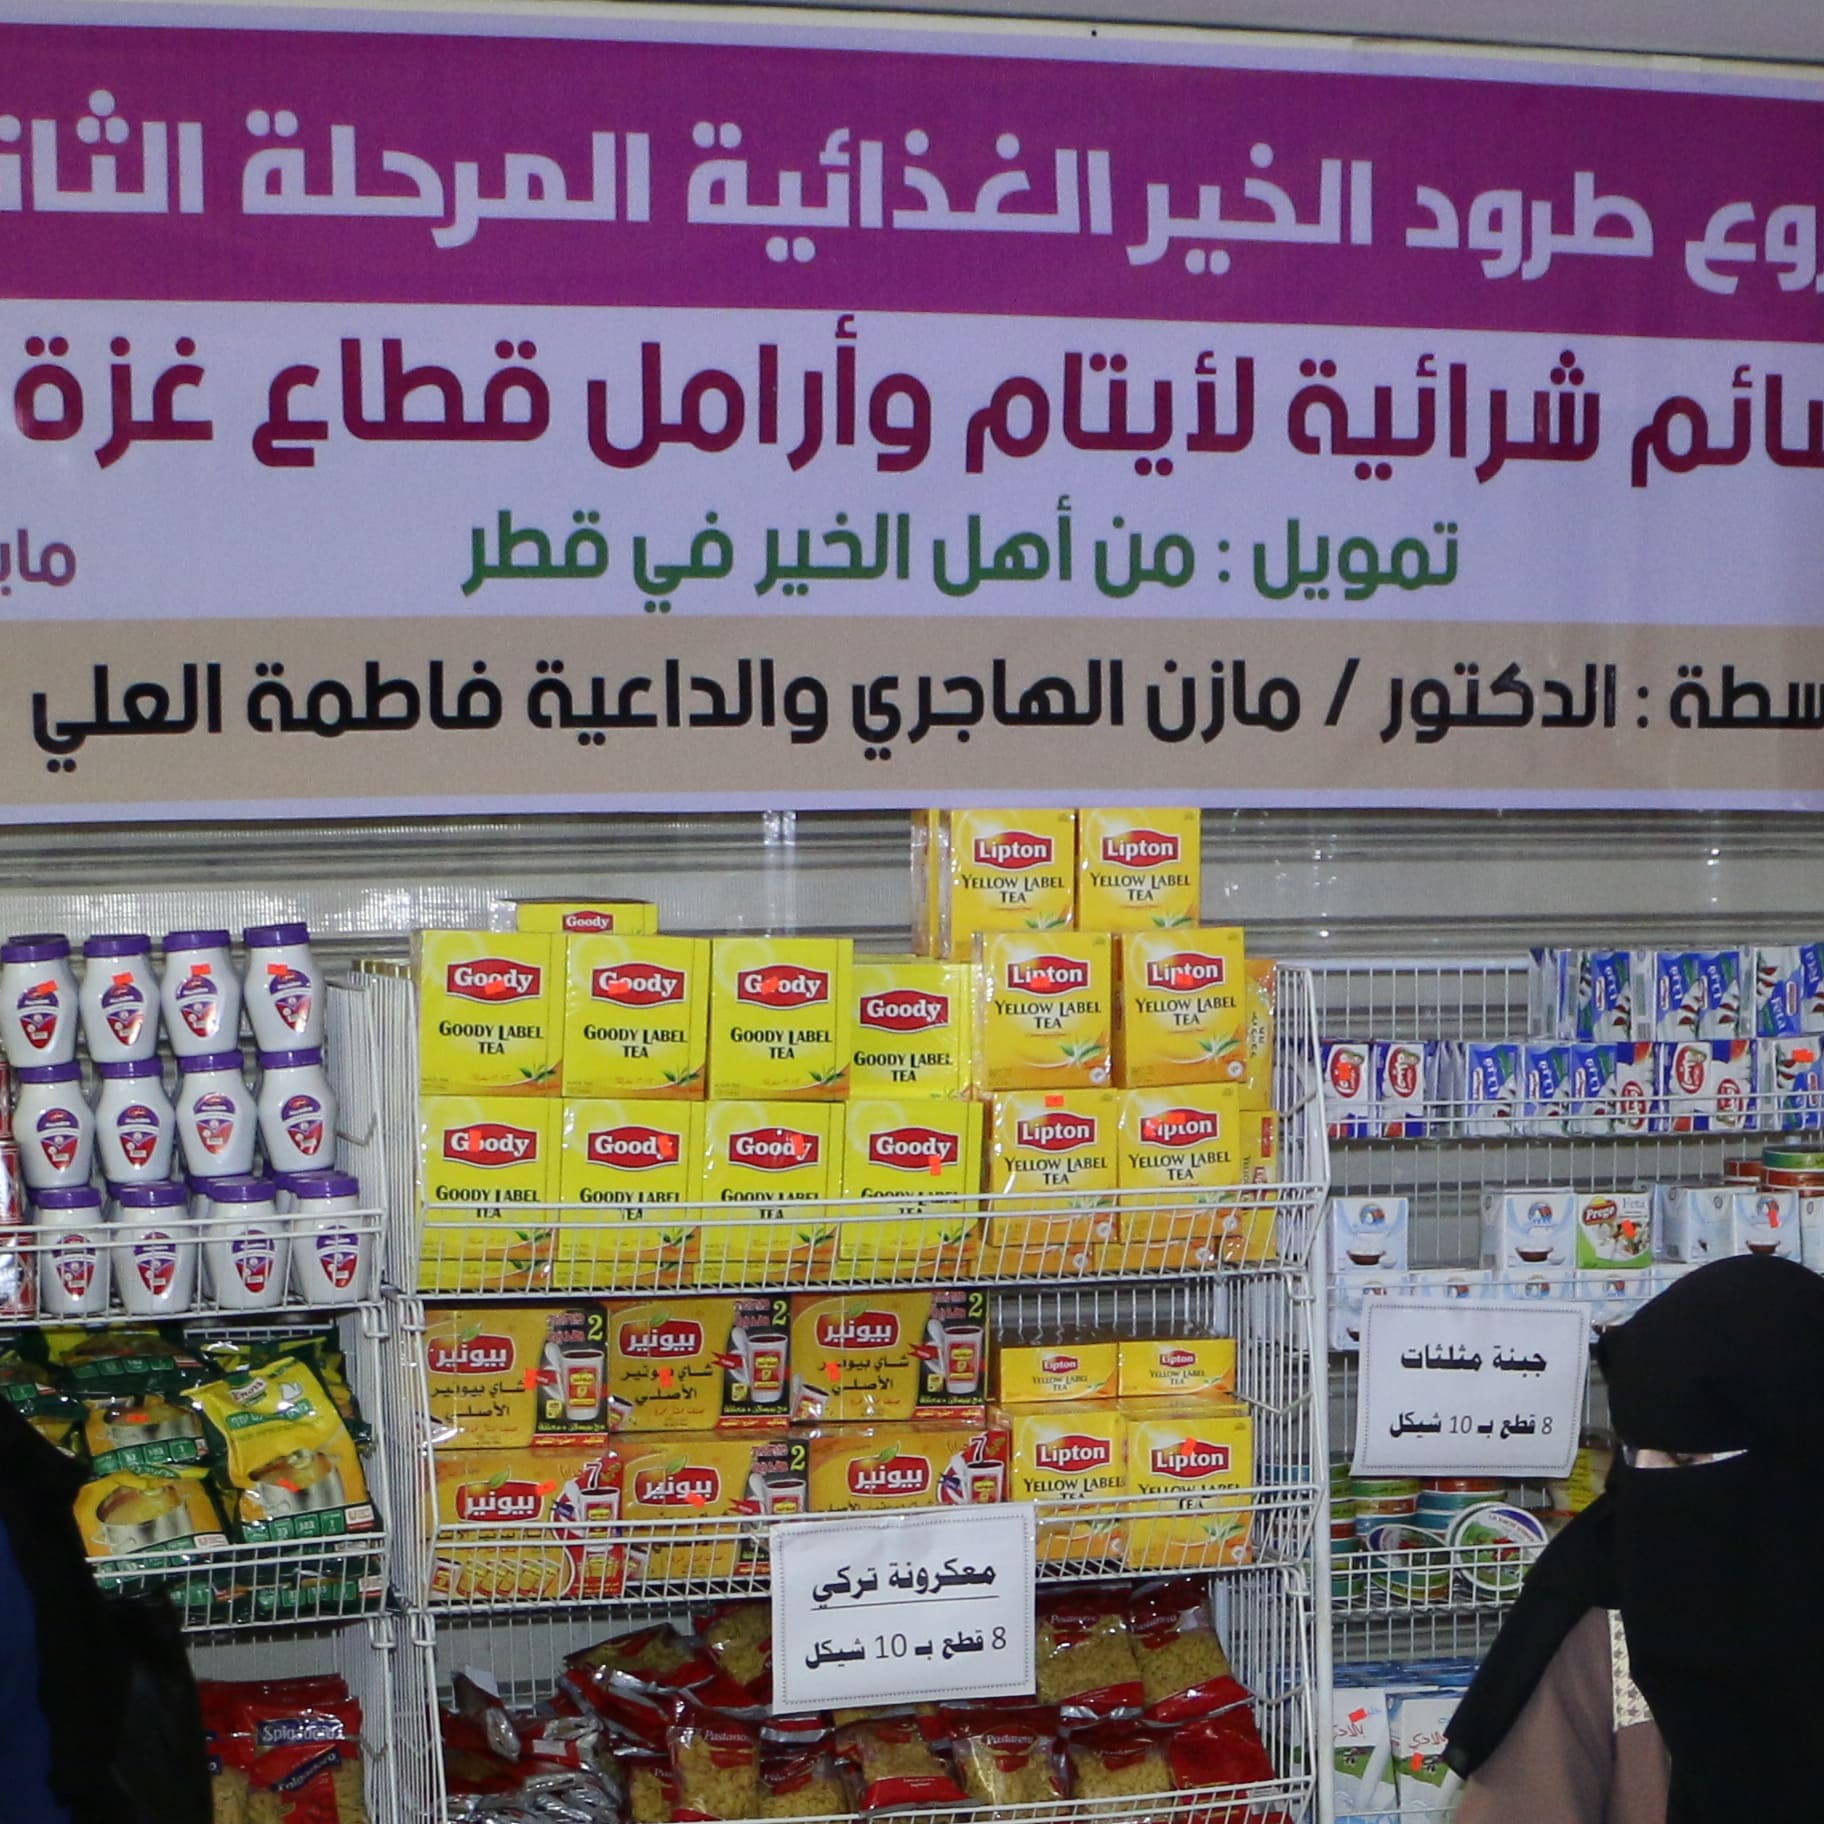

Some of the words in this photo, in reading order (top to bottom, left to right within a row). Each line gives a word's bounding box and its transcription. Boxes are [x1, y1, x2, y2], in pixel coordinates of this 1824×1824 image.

[241, 108, 651, 249] المرحلة
[686, 122, 1113, 266] الغذائية
[1125, 141, 1374, 275] الخير
[1404, 171, 1655, 282] طرود
[12, 334, 214, 471] غزة
[251, 336, 551, 469] قطاع
[587, 312, 933, 474] وأرامل
[964, 349, 1256, 479] لأيتام
[1285, 347, 1601, 486] شرائية
[461, 509, 610, 598] قطر
[752, 511, 911, 598] الخير
[931, 493, 1075, 599] أهل
[1093, 513, 1196, 597] من
[1251, 513, 1460, 601] تمويل
[631, 510, 735, 614] في
[245, 659, 490, 732] فاطمة
[524, 658, 830, 749] والداعية
[1143, 658, 1303, 747] مازن
[1377, 660, 1620, 749] الدكتور
[30, 662, 223, 774] العلي
[849, 656, 1125, 762] الهاجري
[978, 840, 1047, 863] Lipton
[1106, 839, 1174, 861] Lipton
[961, 874, 1018, 890] YELLOW
[1023, 875, 1065, 892] LABEL
[1090, 872, 1146, 888] YELLOW
[1151, 873, 1191, 891] LABEL
[999, 889, 1026, 903] TEA
[1128, 888, 1154, 902] TEA
[566, 915, 610, 929] Goody
[866, 999, 942, 1022] Goody
[994, 999, 1054, 1016] YELLOW
[1059, 1000, 1102, 1017] LABEL
[1135, 997, 1190, 1014] YELLOW
[1195, 996, 1236, 1013] LABEL
[439, 1020, 494, 1038] GOODY
[498, 1024, 544, 1041] LABEL
[1034, 1015, 1062, 1030] TEA
[1173, 1012, 1200, 1026] TEA
[583, 1024, 638, 1042] GOODY
[643, 1027, 688, 1045] LABEL
[730, 1027, 784, 1043] GOODY
[789, 1029, 832, 1046] LABEL
[478, 1040, 505, 1055] TEA
[622, 1045, 649, 1059] TEA
[769, 1046, 795, 1060] TEA
[853, 1050, 906, 1067] GOODY
[890, 1070, 916, 1083] TEA
[1021, 1121, 1091, 1143] Lipton
[876, 1136, 953, 1159] Goody
[1127, 1152, 1186, 1168] YELLOW
[1190, 1151, 1232, 1167] LABEL
[1004, 1156, 1061, 1172] YELLOW
[1066, 1156, 1108, 1173] LABEL
[1167, 1167, 1195, 1181] TEA
[1043, 1172, 1070, 1187] TEA
[436, 1184, 489, 1202] GOODY
[1582, 1206, 1617, 1224] Prego
[772, 1300, 787, 1325] 2
[587, 1314, 603, 1341] 2
[1043, 1357, 1078, 1372] Lipton
[1160, 1352, 1194, 1367] Lipton
[1401, 1344, 1483, 1373] مثلثات
[1492, 1345, 1547, 1378] جبنة
[1389, 1412, 1443, 1439] شيكل
[1448, 1415, 1473, 1434] 10
[1499, 1413, 1536, 1440] قطع
[1541, 1416, 1553, 1435] 8
[1040, 1441, 1107, 1465] Lipton
[1155, 1449, 1224, 1473] Lipton
[811, 1568, 879, 1608] تركي
[887, 1556, 997, 1596] معكرونة
[874, 1632, 907, 1659] 10
[940, 1629, 984, 1660] قطع
[991, 1625, 1007, 1650] 8
[805, 1636, 866, 1669] شيكل
